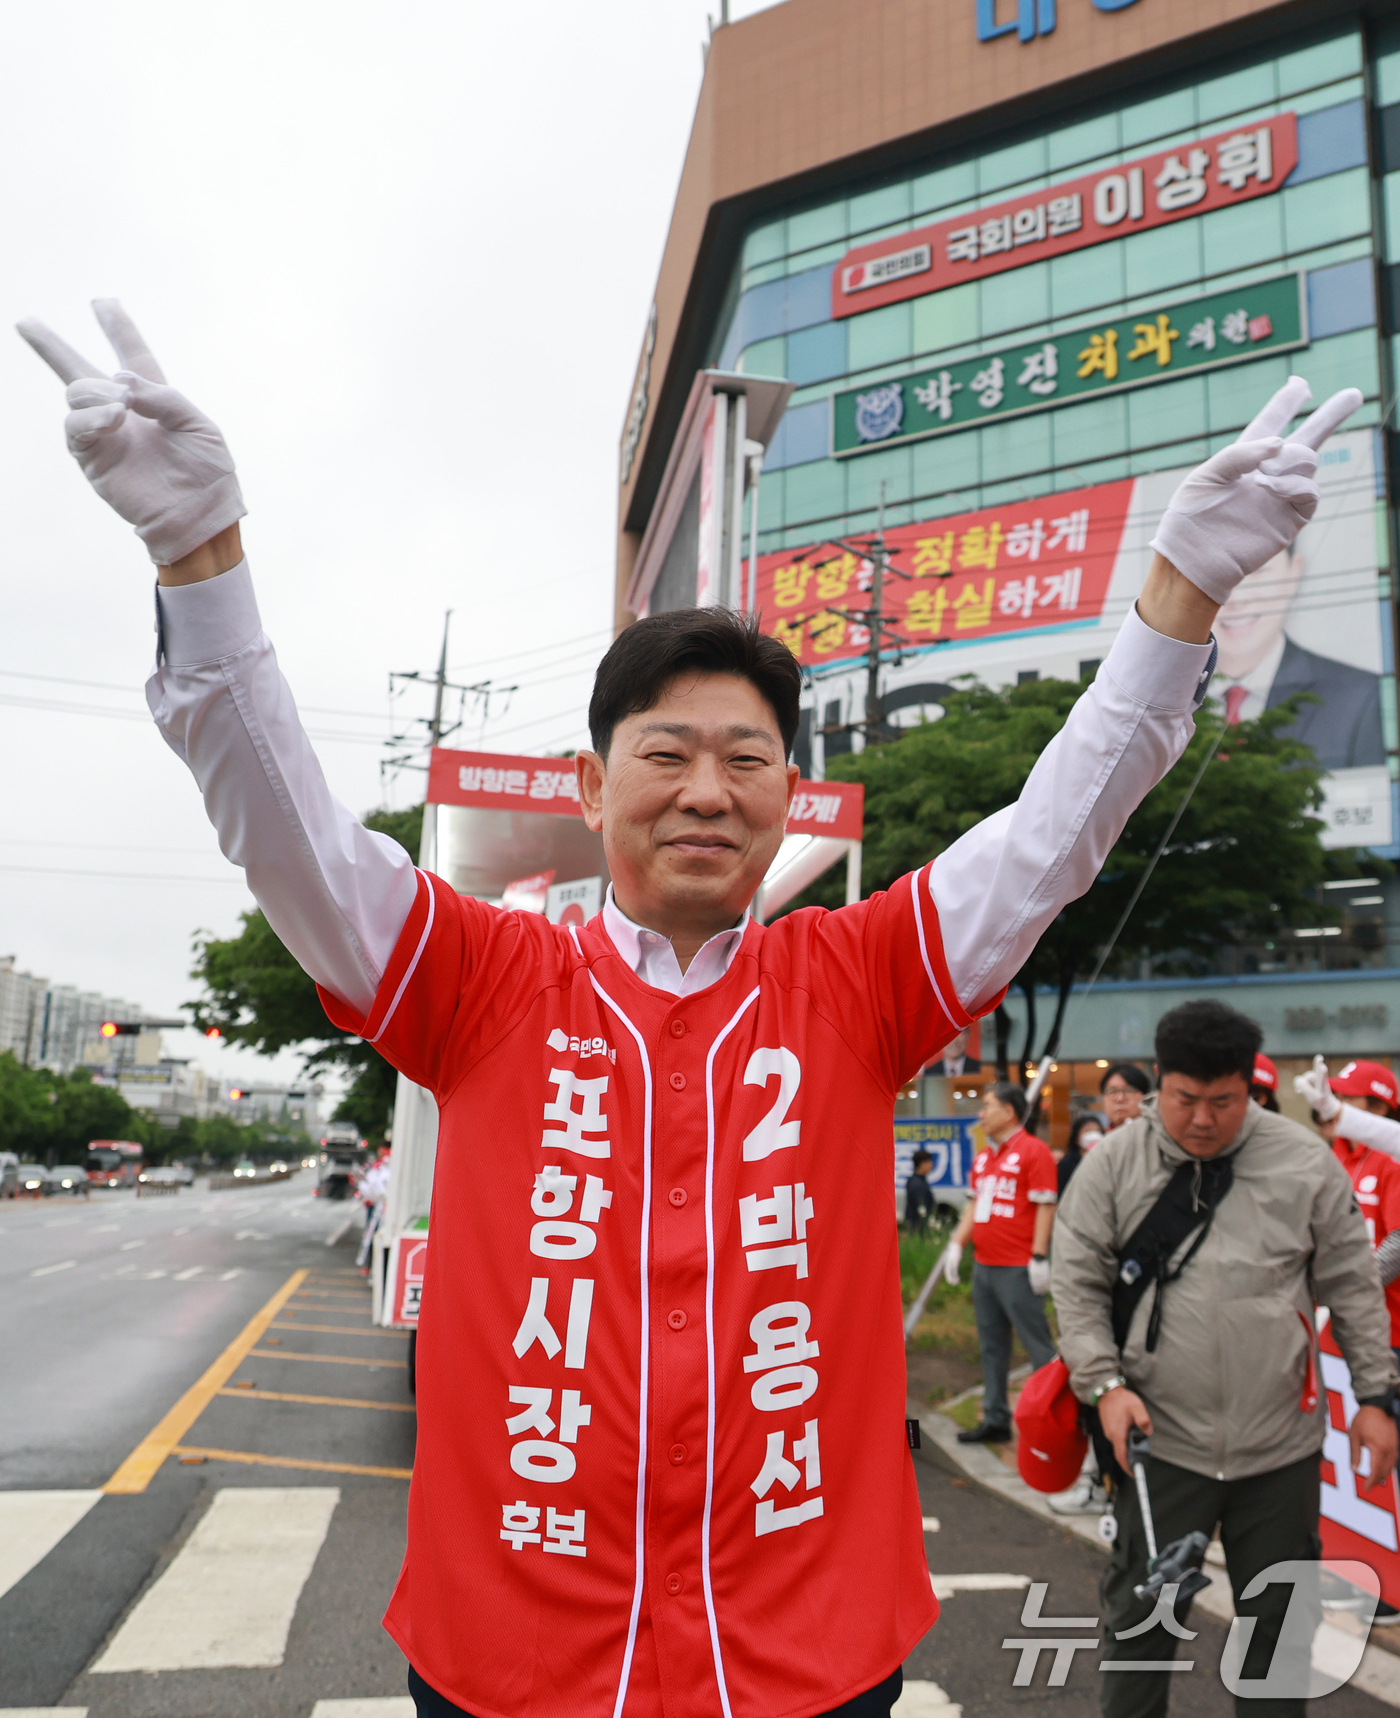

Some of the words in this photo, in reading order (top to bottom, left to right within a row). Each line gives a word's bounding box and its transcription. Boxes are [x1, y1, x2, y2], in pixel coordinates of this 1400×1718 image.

[946, 192, 1082, 262] 국회의원
[1093, 126, 1273, 227] 이상휘
[913, 343, 1059, 421] 박영진
[1076, 313, 1180, 380] 치과
[911, 507, 1090, 578] 정확하게
[903, 565, 1083, 636] 확실하게
[458, 764, 528, 796] 방향은
[742, 1046, 802, 1162] 2
[504, 1067, 613, 1484] 포항시장
[738, 1182, 825, 1538] 박용선
[499, 1500, 588, 1558] 후보
